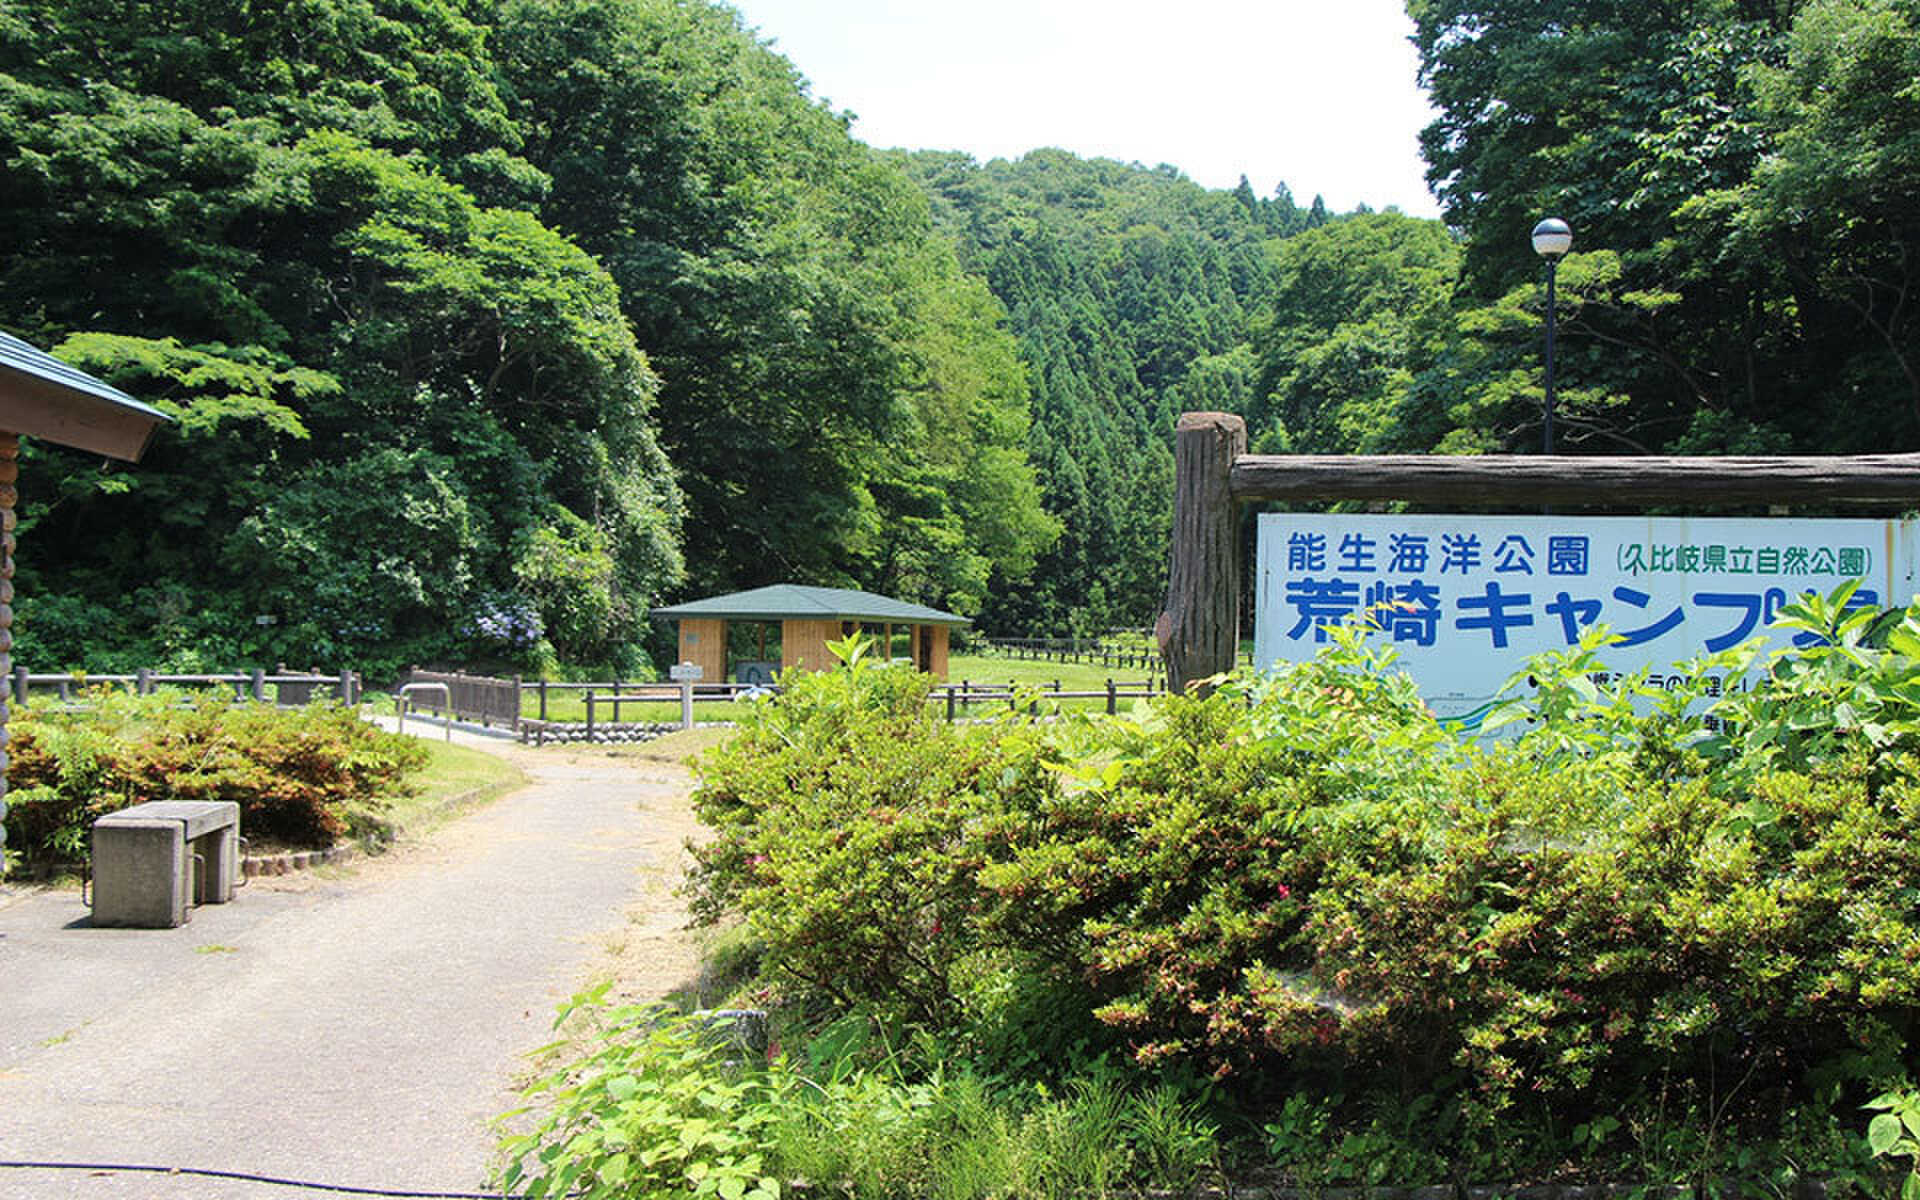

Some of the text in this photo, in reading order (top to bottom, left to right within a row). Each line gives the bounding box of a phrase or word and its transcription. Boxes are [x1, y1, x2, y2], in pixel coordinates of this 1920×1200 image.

[1287, 531, 1590, 575] 能生海洋公園
